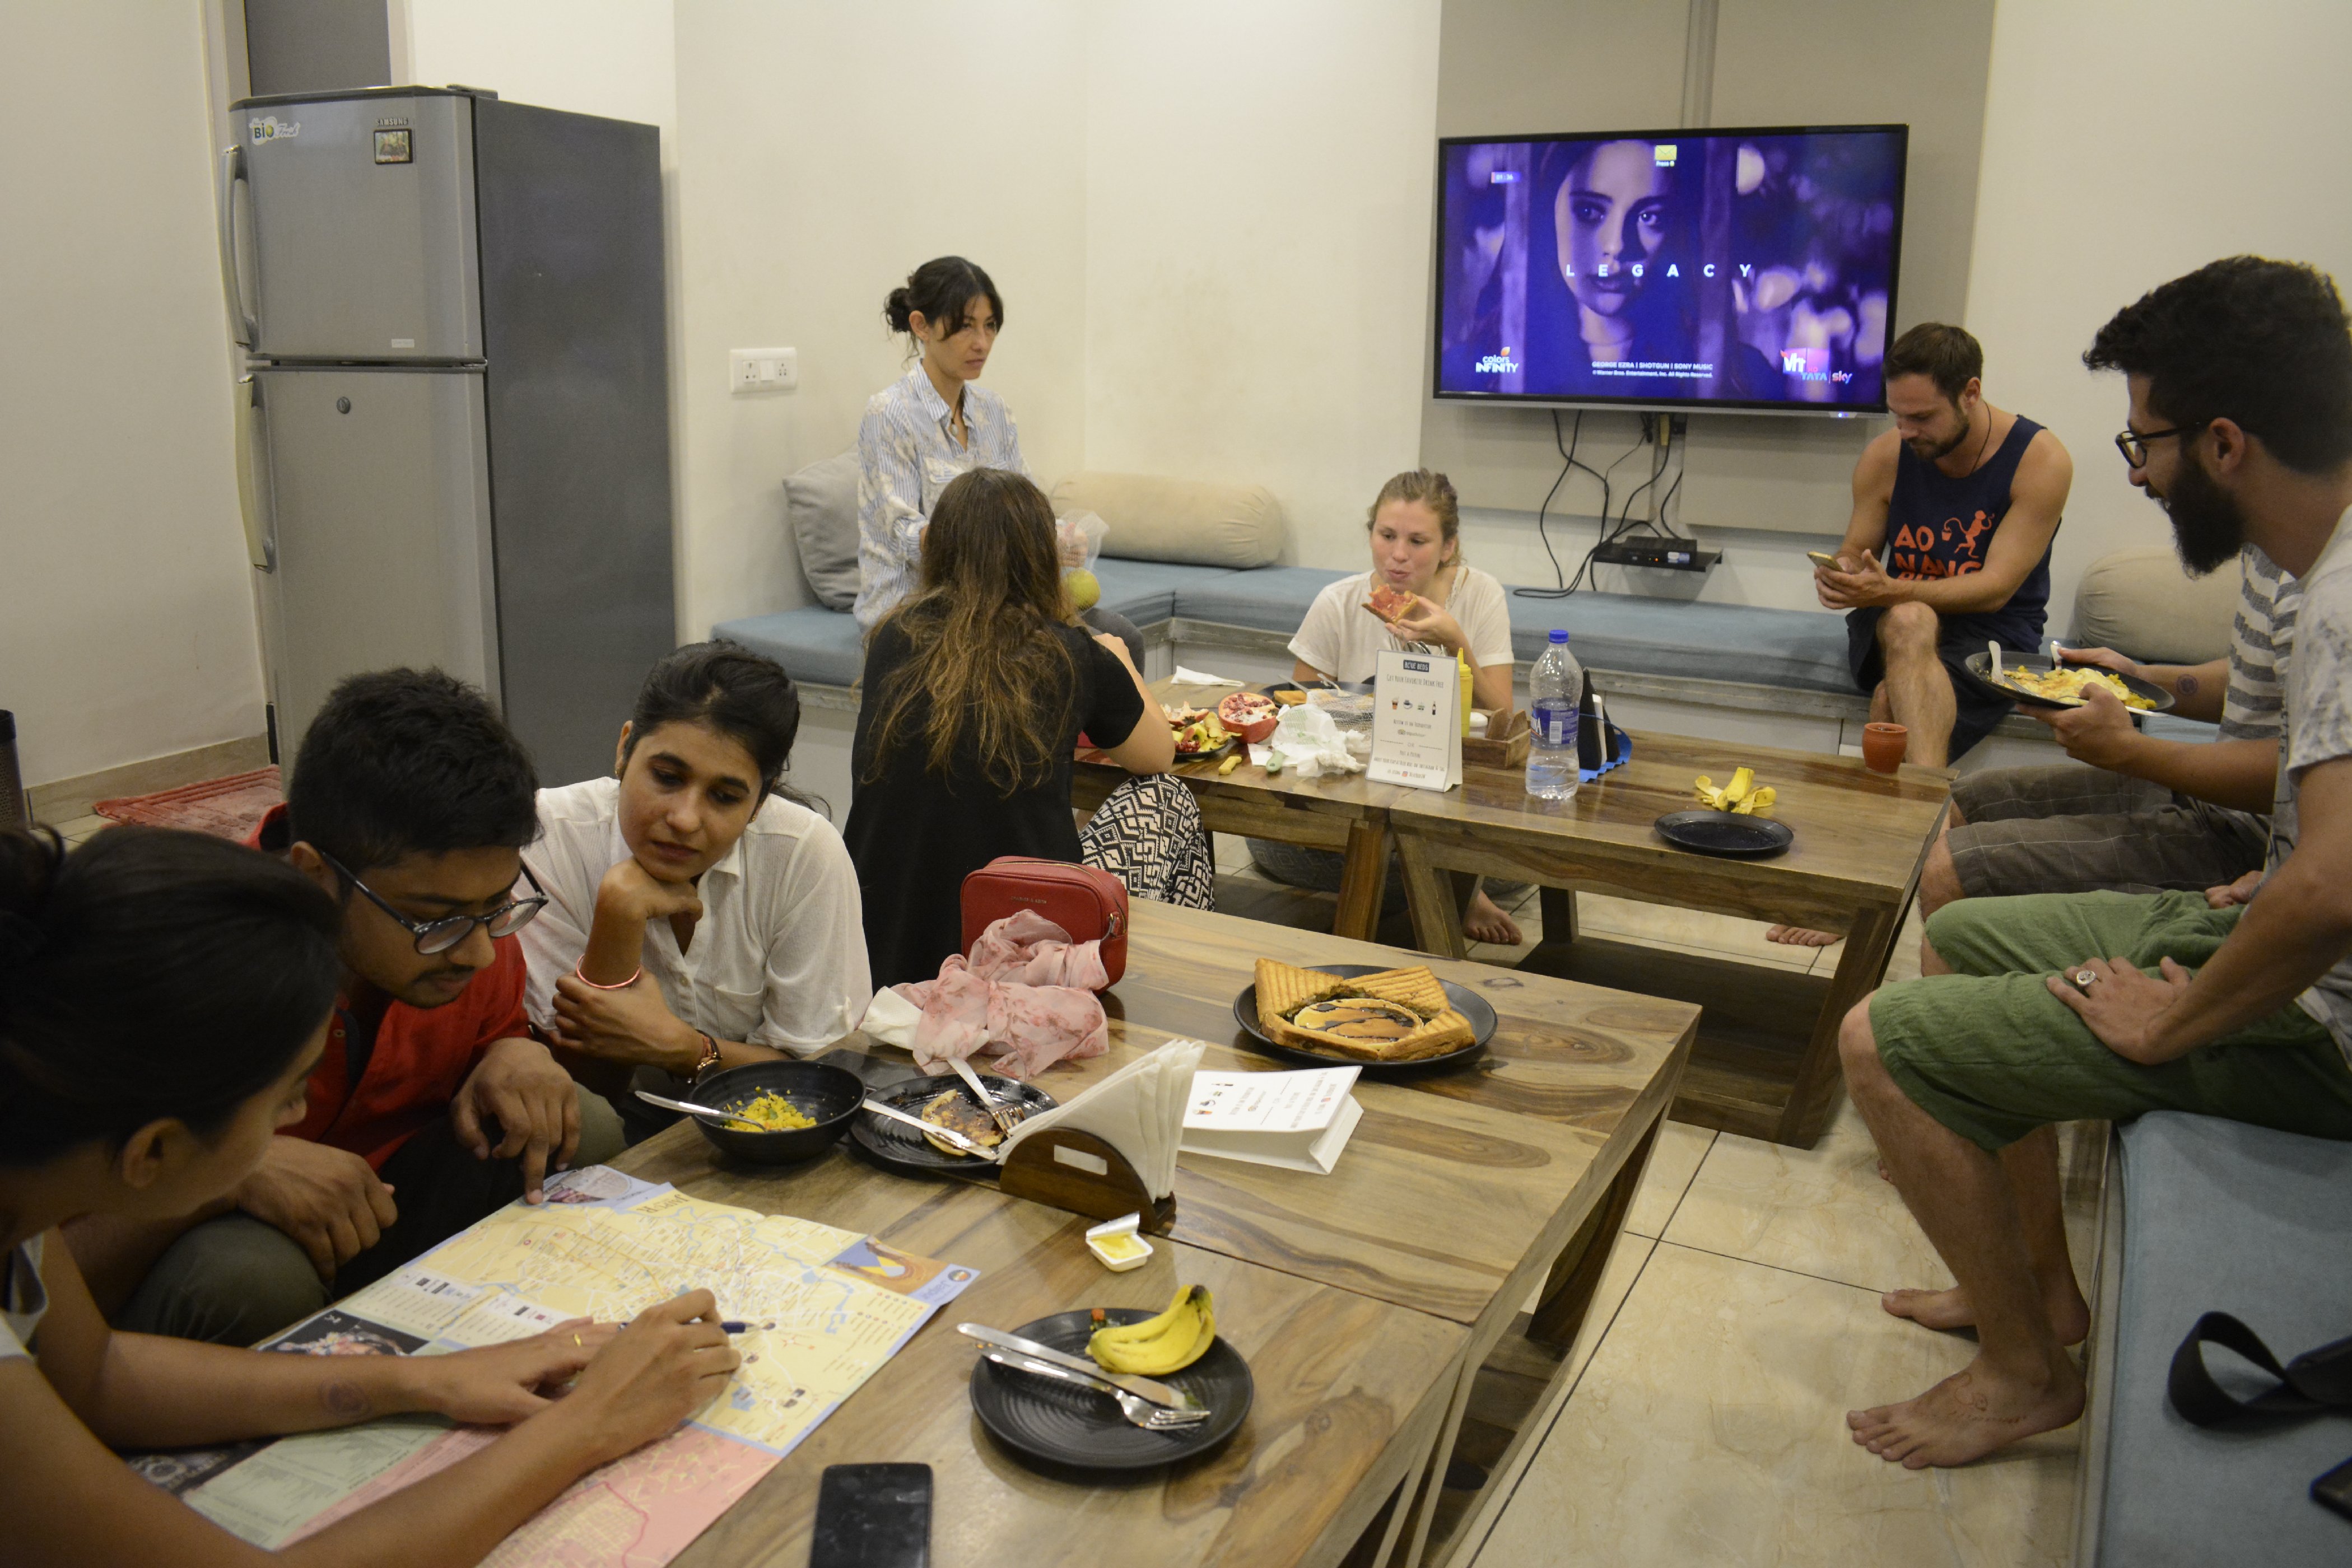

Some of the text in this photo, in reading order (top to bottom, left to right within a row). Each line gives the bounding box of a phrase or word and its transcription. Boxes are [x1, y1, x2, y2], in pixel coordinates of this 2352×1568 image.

[376, 118, 408, 126] SAMSUNG
[1482, 354, 1511, 364] colors
[1475, 362, 1519, 373] INFINITY
[1801, 370, 1853, 385] TATA sky
[1894, 523, 1935, 552] AO
